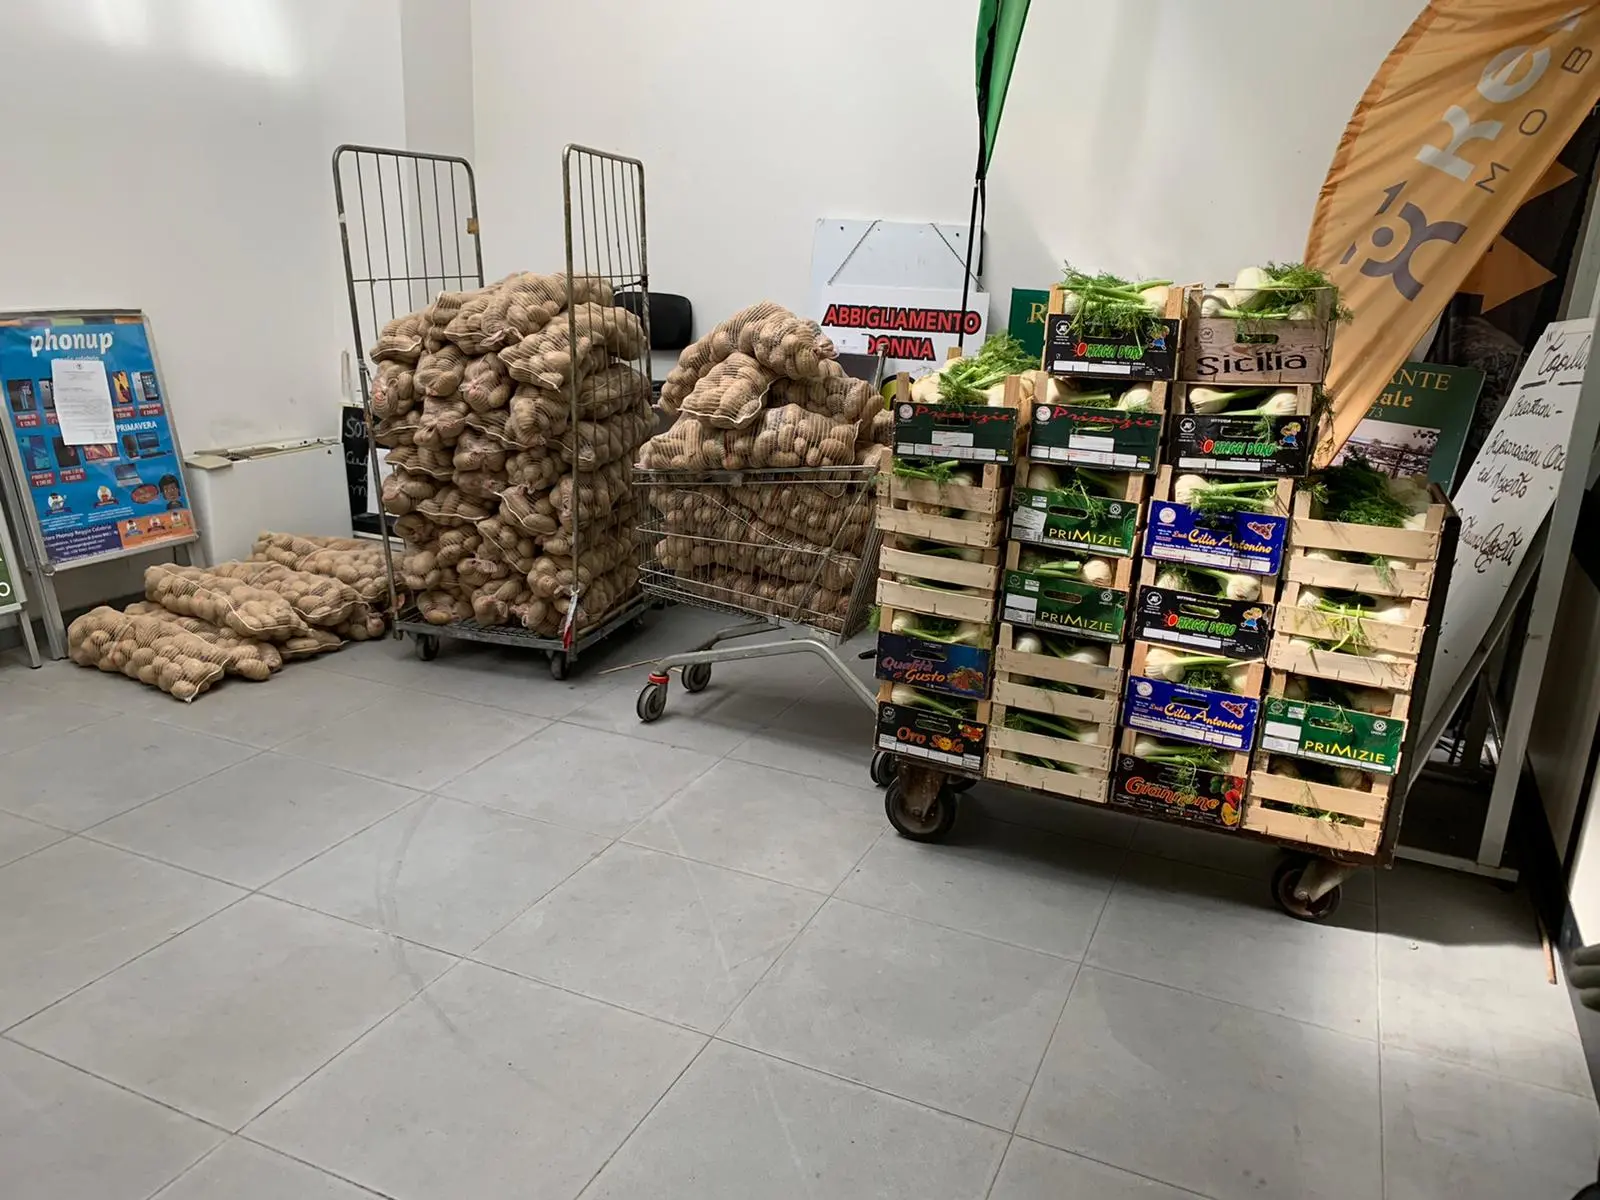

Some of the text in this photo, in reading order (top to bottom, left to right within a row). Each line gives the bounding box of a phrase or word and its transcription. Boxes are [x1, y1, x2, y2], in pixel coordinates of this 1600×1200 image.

[821, 303, 982, 335] ABBIGLIAMENTO
[30, 328, 113, 357] phonup
[1197, 351, 1307, 376] Sicilia
[1375, 390, 1413, 408] ale
[116, 421, 158, 432] PRIMAVERA
[1049, 528, 1122, 546] PRIMIZIE
[1188, 528, 1217, 546] Cilia
[1218, 534, 1273, 553] Antonino
[1041, 611, 1113, 632] PRIMIZIE
[905, 668, 946, 684] Gusto
[1164, 703, 1191, 720] Cilia
[1192, 710, 1244, 731] Antonino
[1304, 740, 1386, 764] PRIMIZIE
